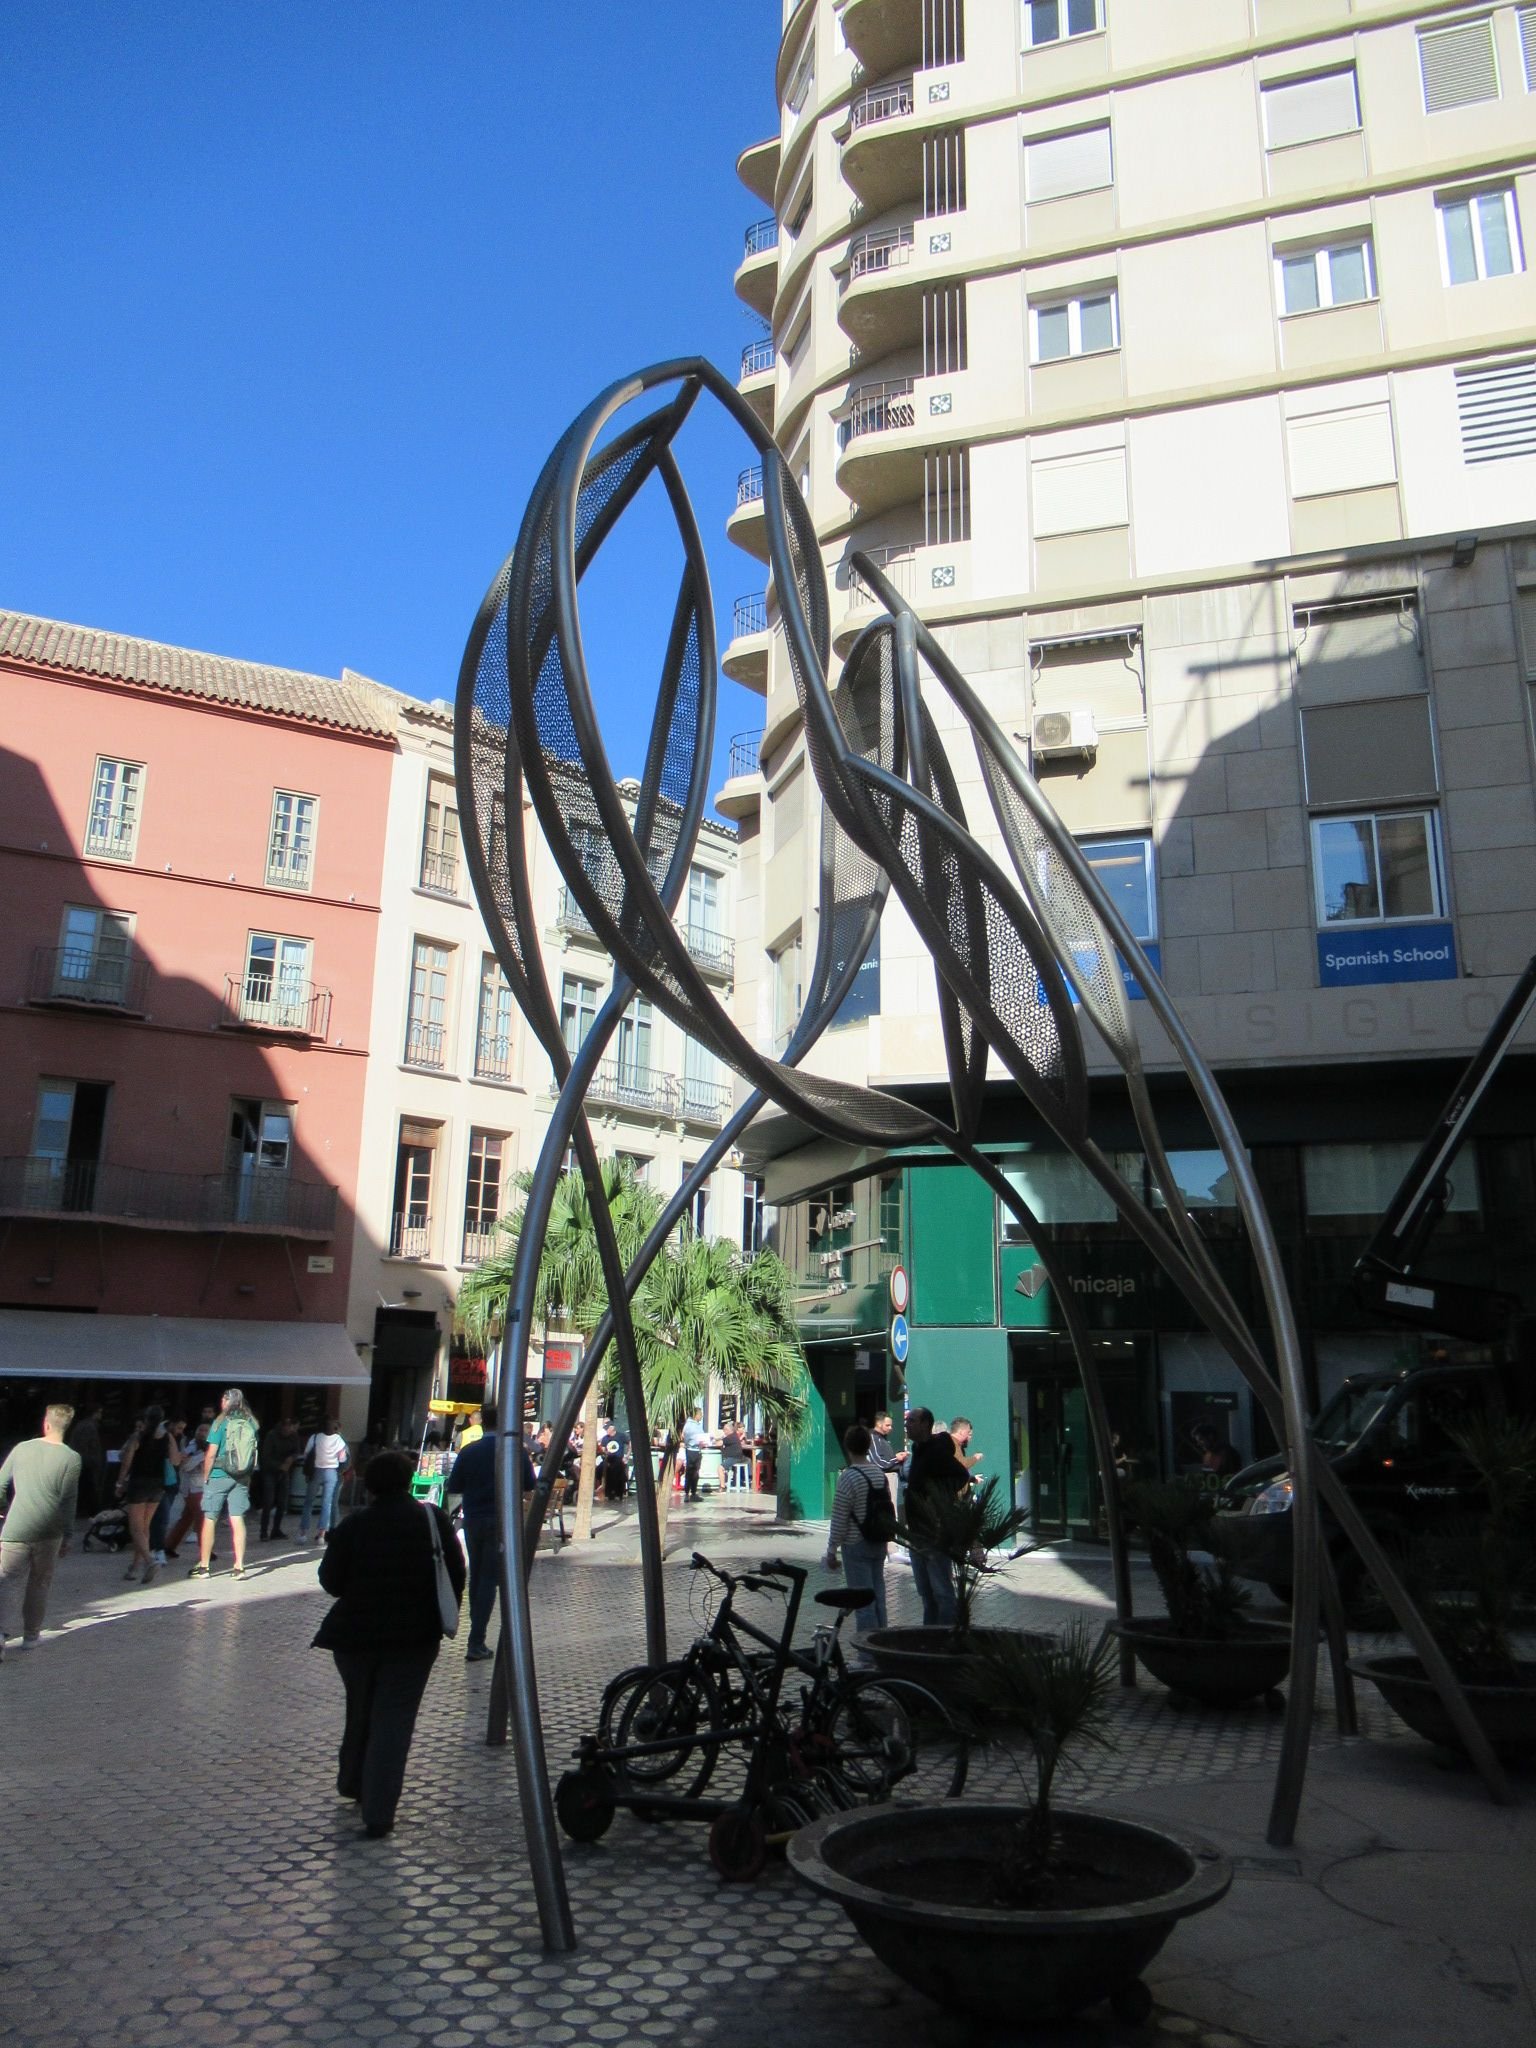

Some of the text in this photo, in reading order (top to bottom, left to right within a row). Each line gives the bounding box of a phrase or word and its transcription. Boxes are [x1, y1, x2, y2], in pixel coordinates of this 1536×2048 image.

[1325, 946, 1449, 970] Spanish School
[1245, 992, 1500, 1043] SIGLO
